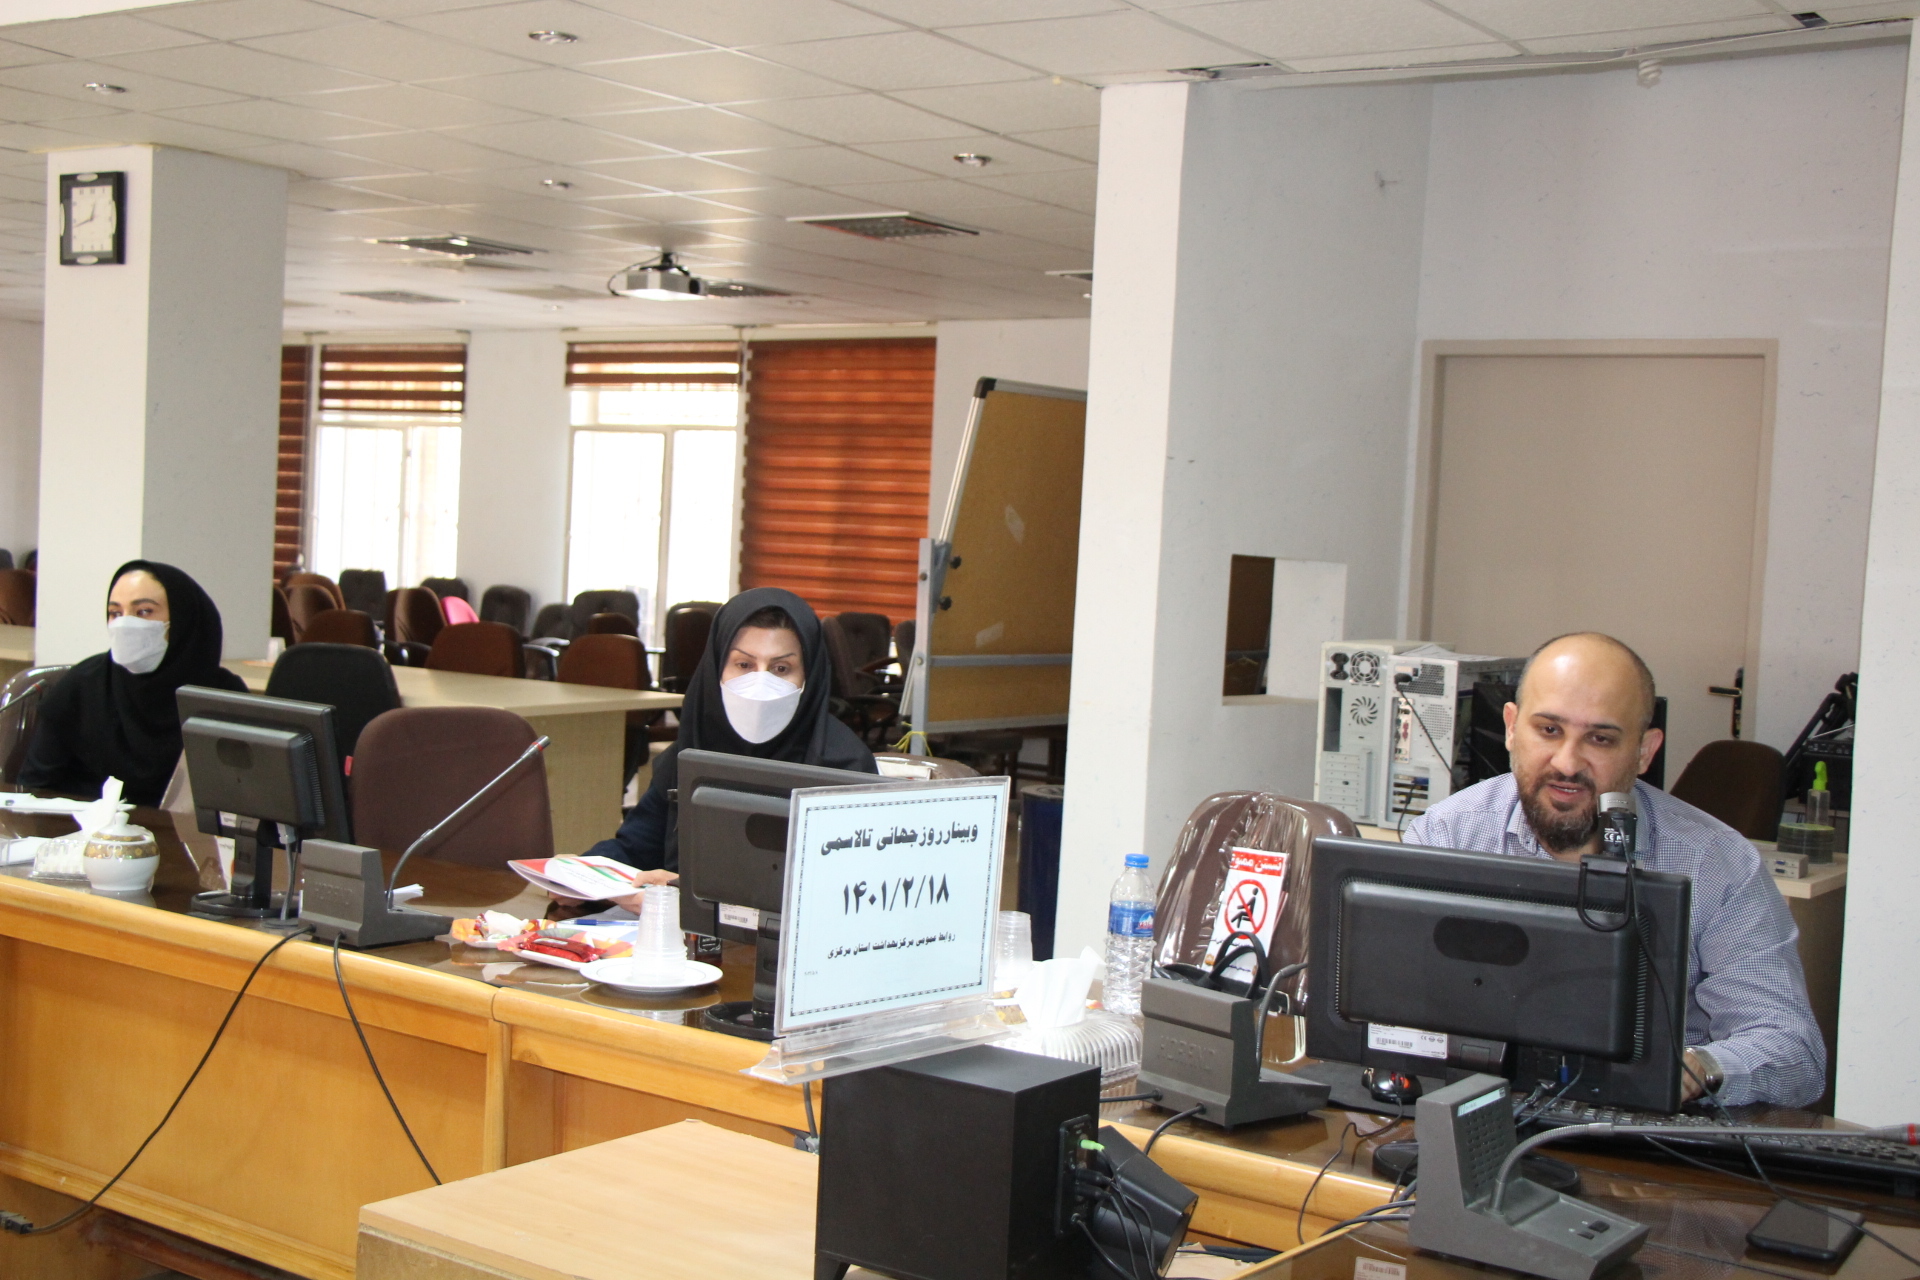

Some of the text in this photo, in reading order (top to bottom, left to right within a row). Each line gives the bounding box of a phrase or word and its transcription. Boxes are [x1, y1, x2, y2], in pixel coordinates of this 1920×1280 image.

[820, 821, 978, 856] وبینار روز جهانی تالاسمی
[842, 872, 950, 916] ۱۴۰۱/۲/۱۸
[915, 935, 936, 946] عمومی
[938, 931, 956, 943] روابط
[827, 946, 851, 959] مرکزی
[853, 942, 870, 955] استان
